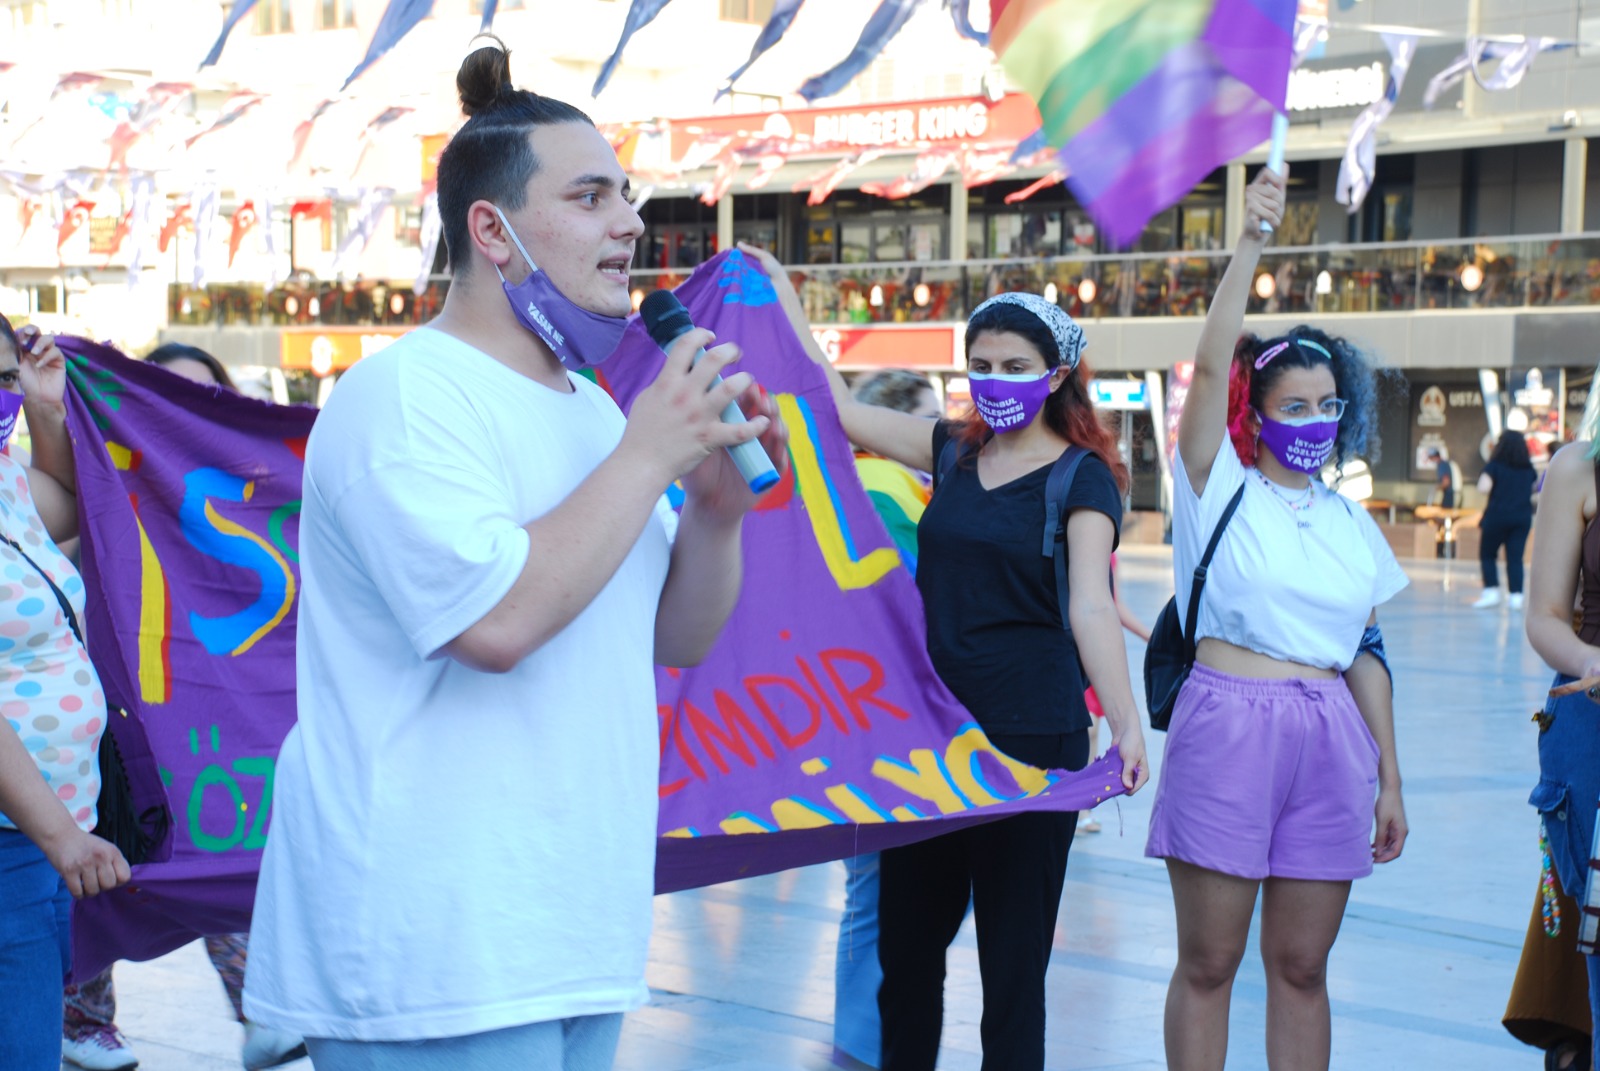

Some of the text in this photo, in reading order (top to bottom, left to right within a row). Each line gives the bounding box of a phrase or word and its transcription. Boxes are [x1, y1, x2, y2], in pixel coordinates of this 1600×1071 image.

[814, 102, 987, 145] BURGER KING
[527, 301, 554, 336] YASAK
[552, 329, 565, 346] NE
[976, 401, 1024, 418] SÖZLEŞMESİ
[978, 392, 1018, 409] İSTANBUL
